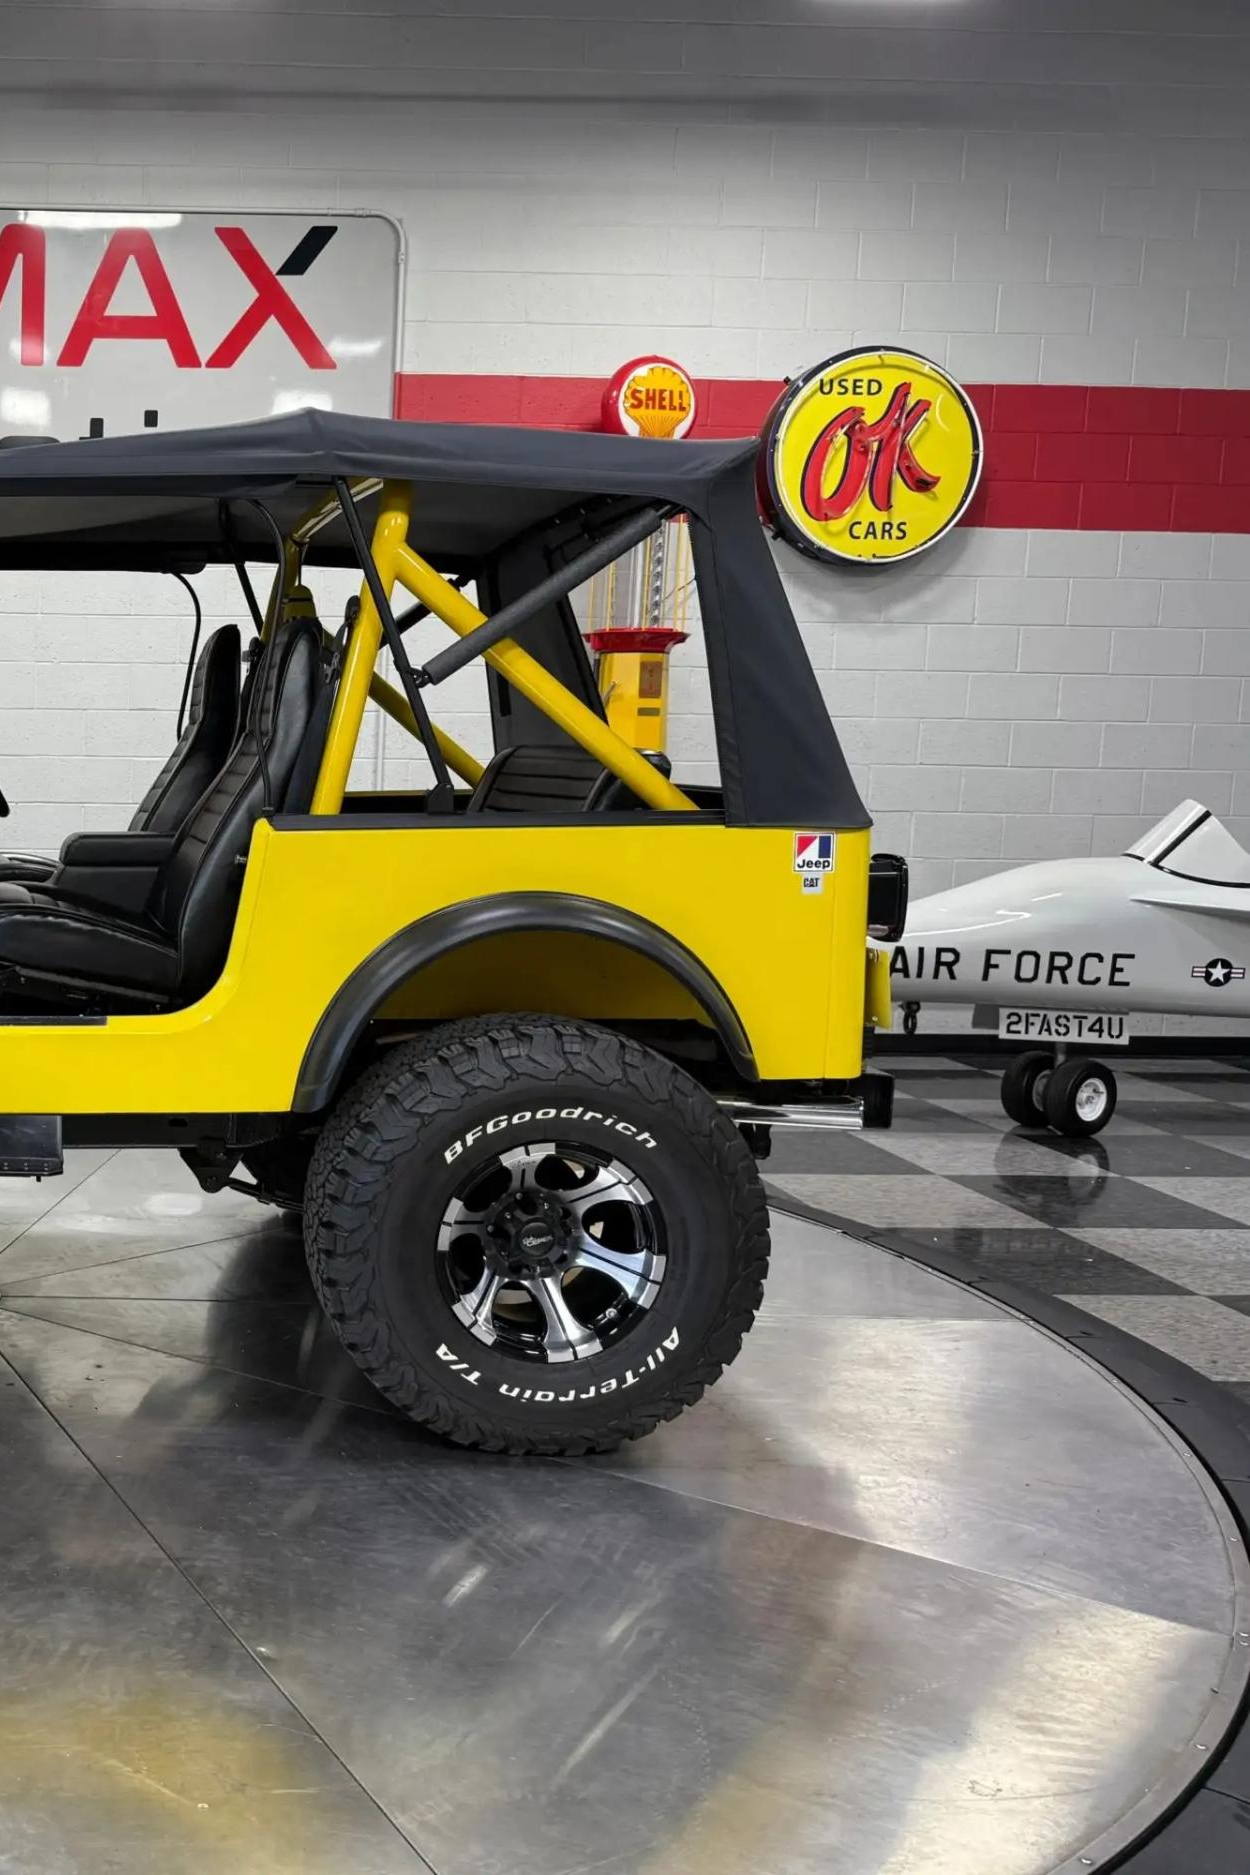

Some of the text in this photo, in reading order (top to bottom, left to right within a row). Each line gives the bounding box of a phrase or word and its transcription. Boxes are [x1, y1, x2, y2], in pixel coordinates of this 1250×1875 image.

[819, 379, 882, 395] USED
[630, 388, 686, 411] SHELL
[848, 521, 907, 539] CARS
[797, 859, 831, 870] Jeep
[803, 877, 820, 888] CAT
[890, 946, 1136, 987] AIR FORCE
[1006, 1012, 1124, 1039] 2FAST4U
[444, 1107, 657, 1164] BFGoodrich
[435, 1326, 679, 1402] All-Terrain T/A
